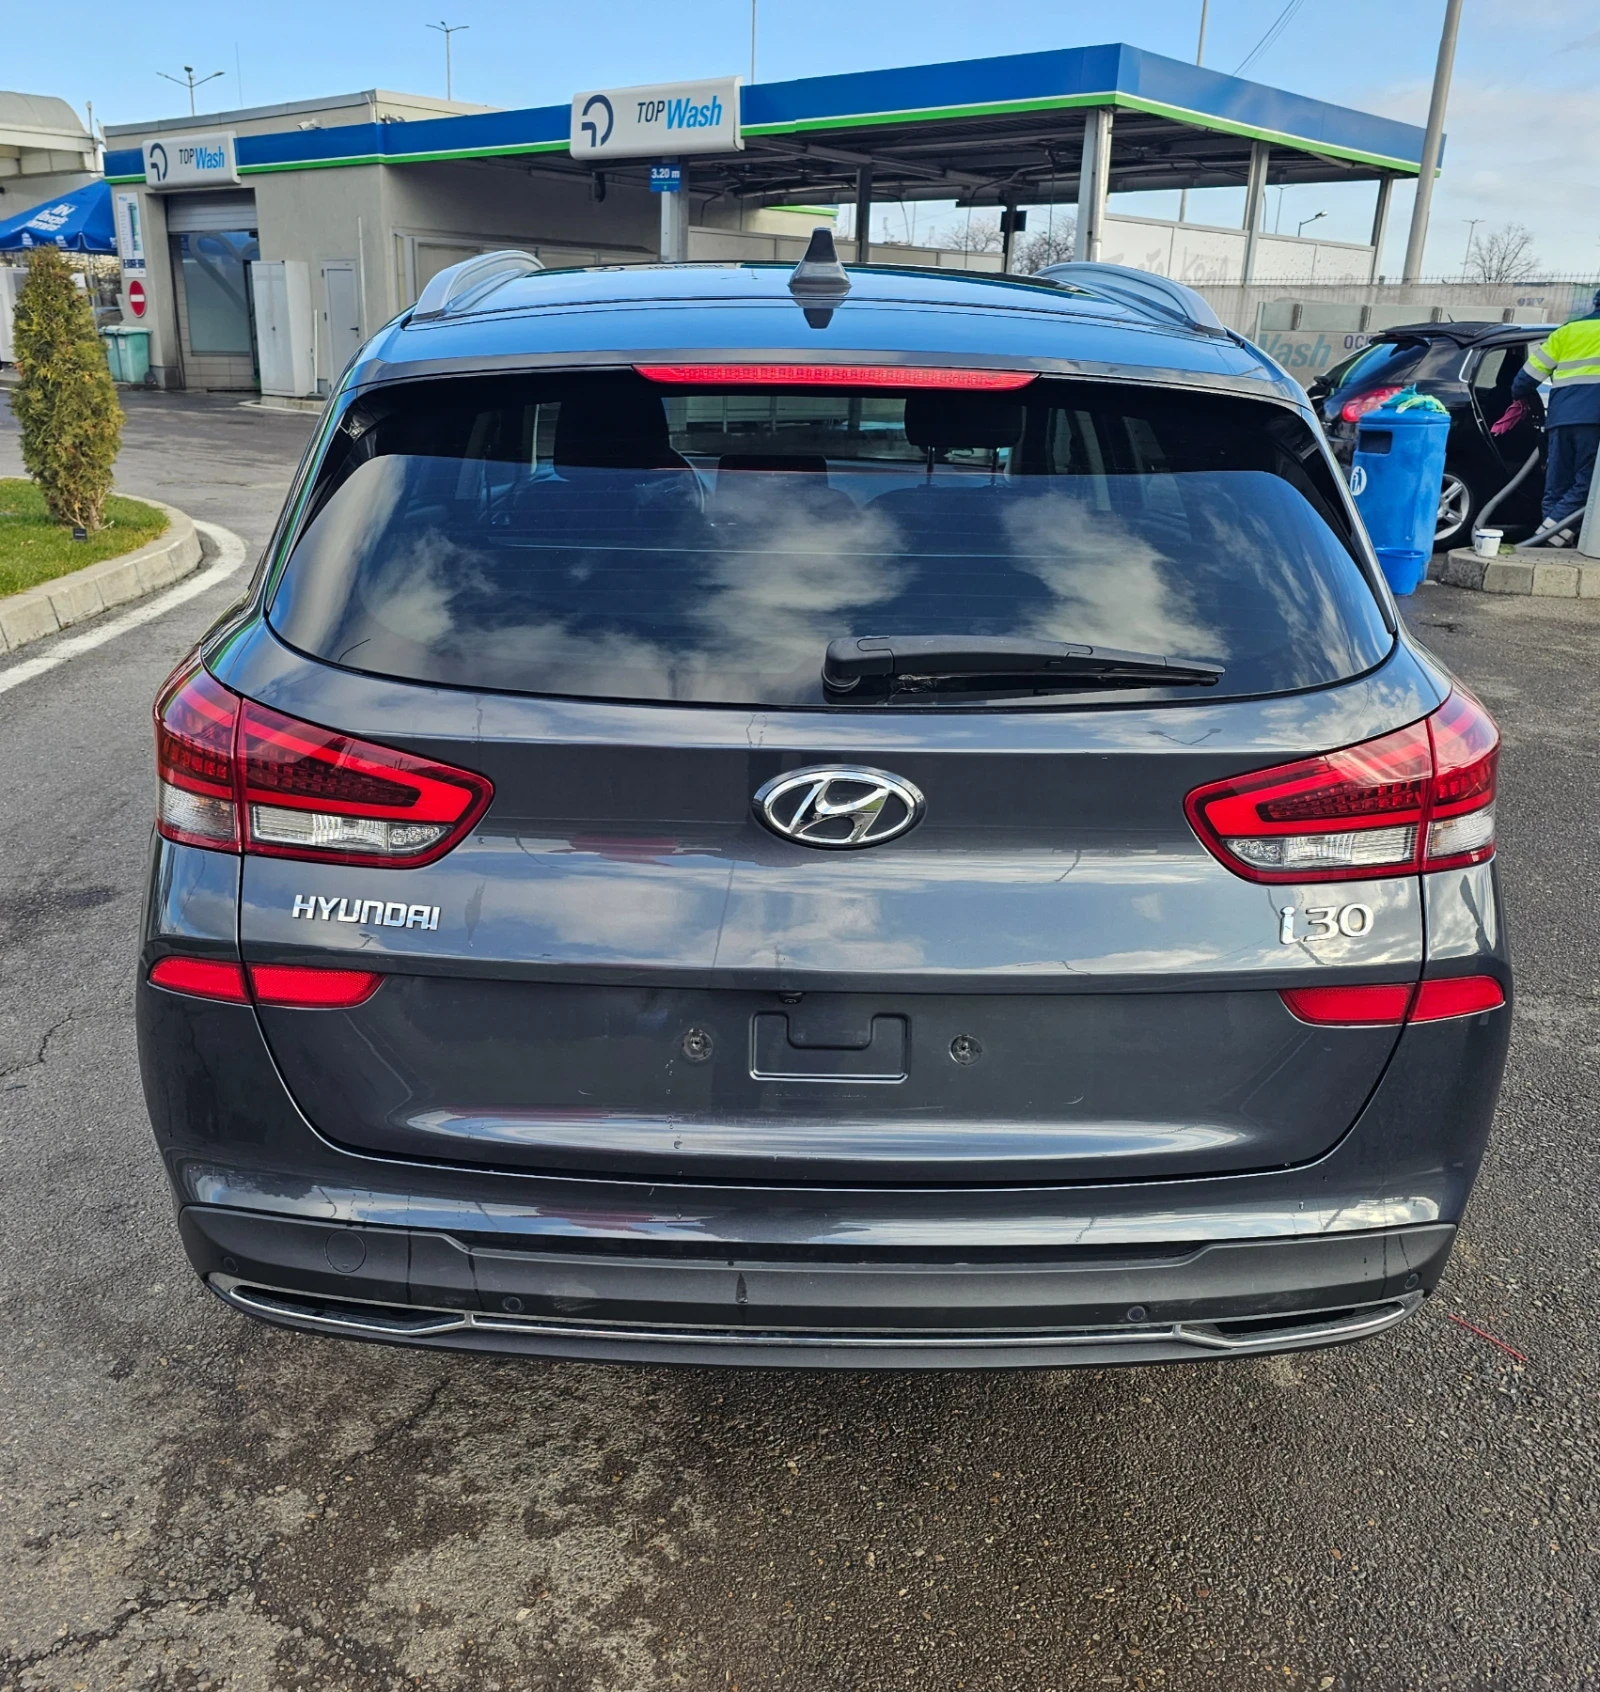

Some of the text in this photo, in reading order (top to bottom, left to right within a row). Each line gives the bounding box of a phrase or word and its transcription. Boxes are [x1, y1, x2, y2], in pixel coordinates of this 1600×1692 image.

[637, 95, 723, 130] TOP Wash
[179, 145, 225, 170] TOP Wash
[651, 168, 681, 179] 3.20 m
[291, 894, 441, 931] HYUNDAI
[1279, 903, 1375, 945] i30
